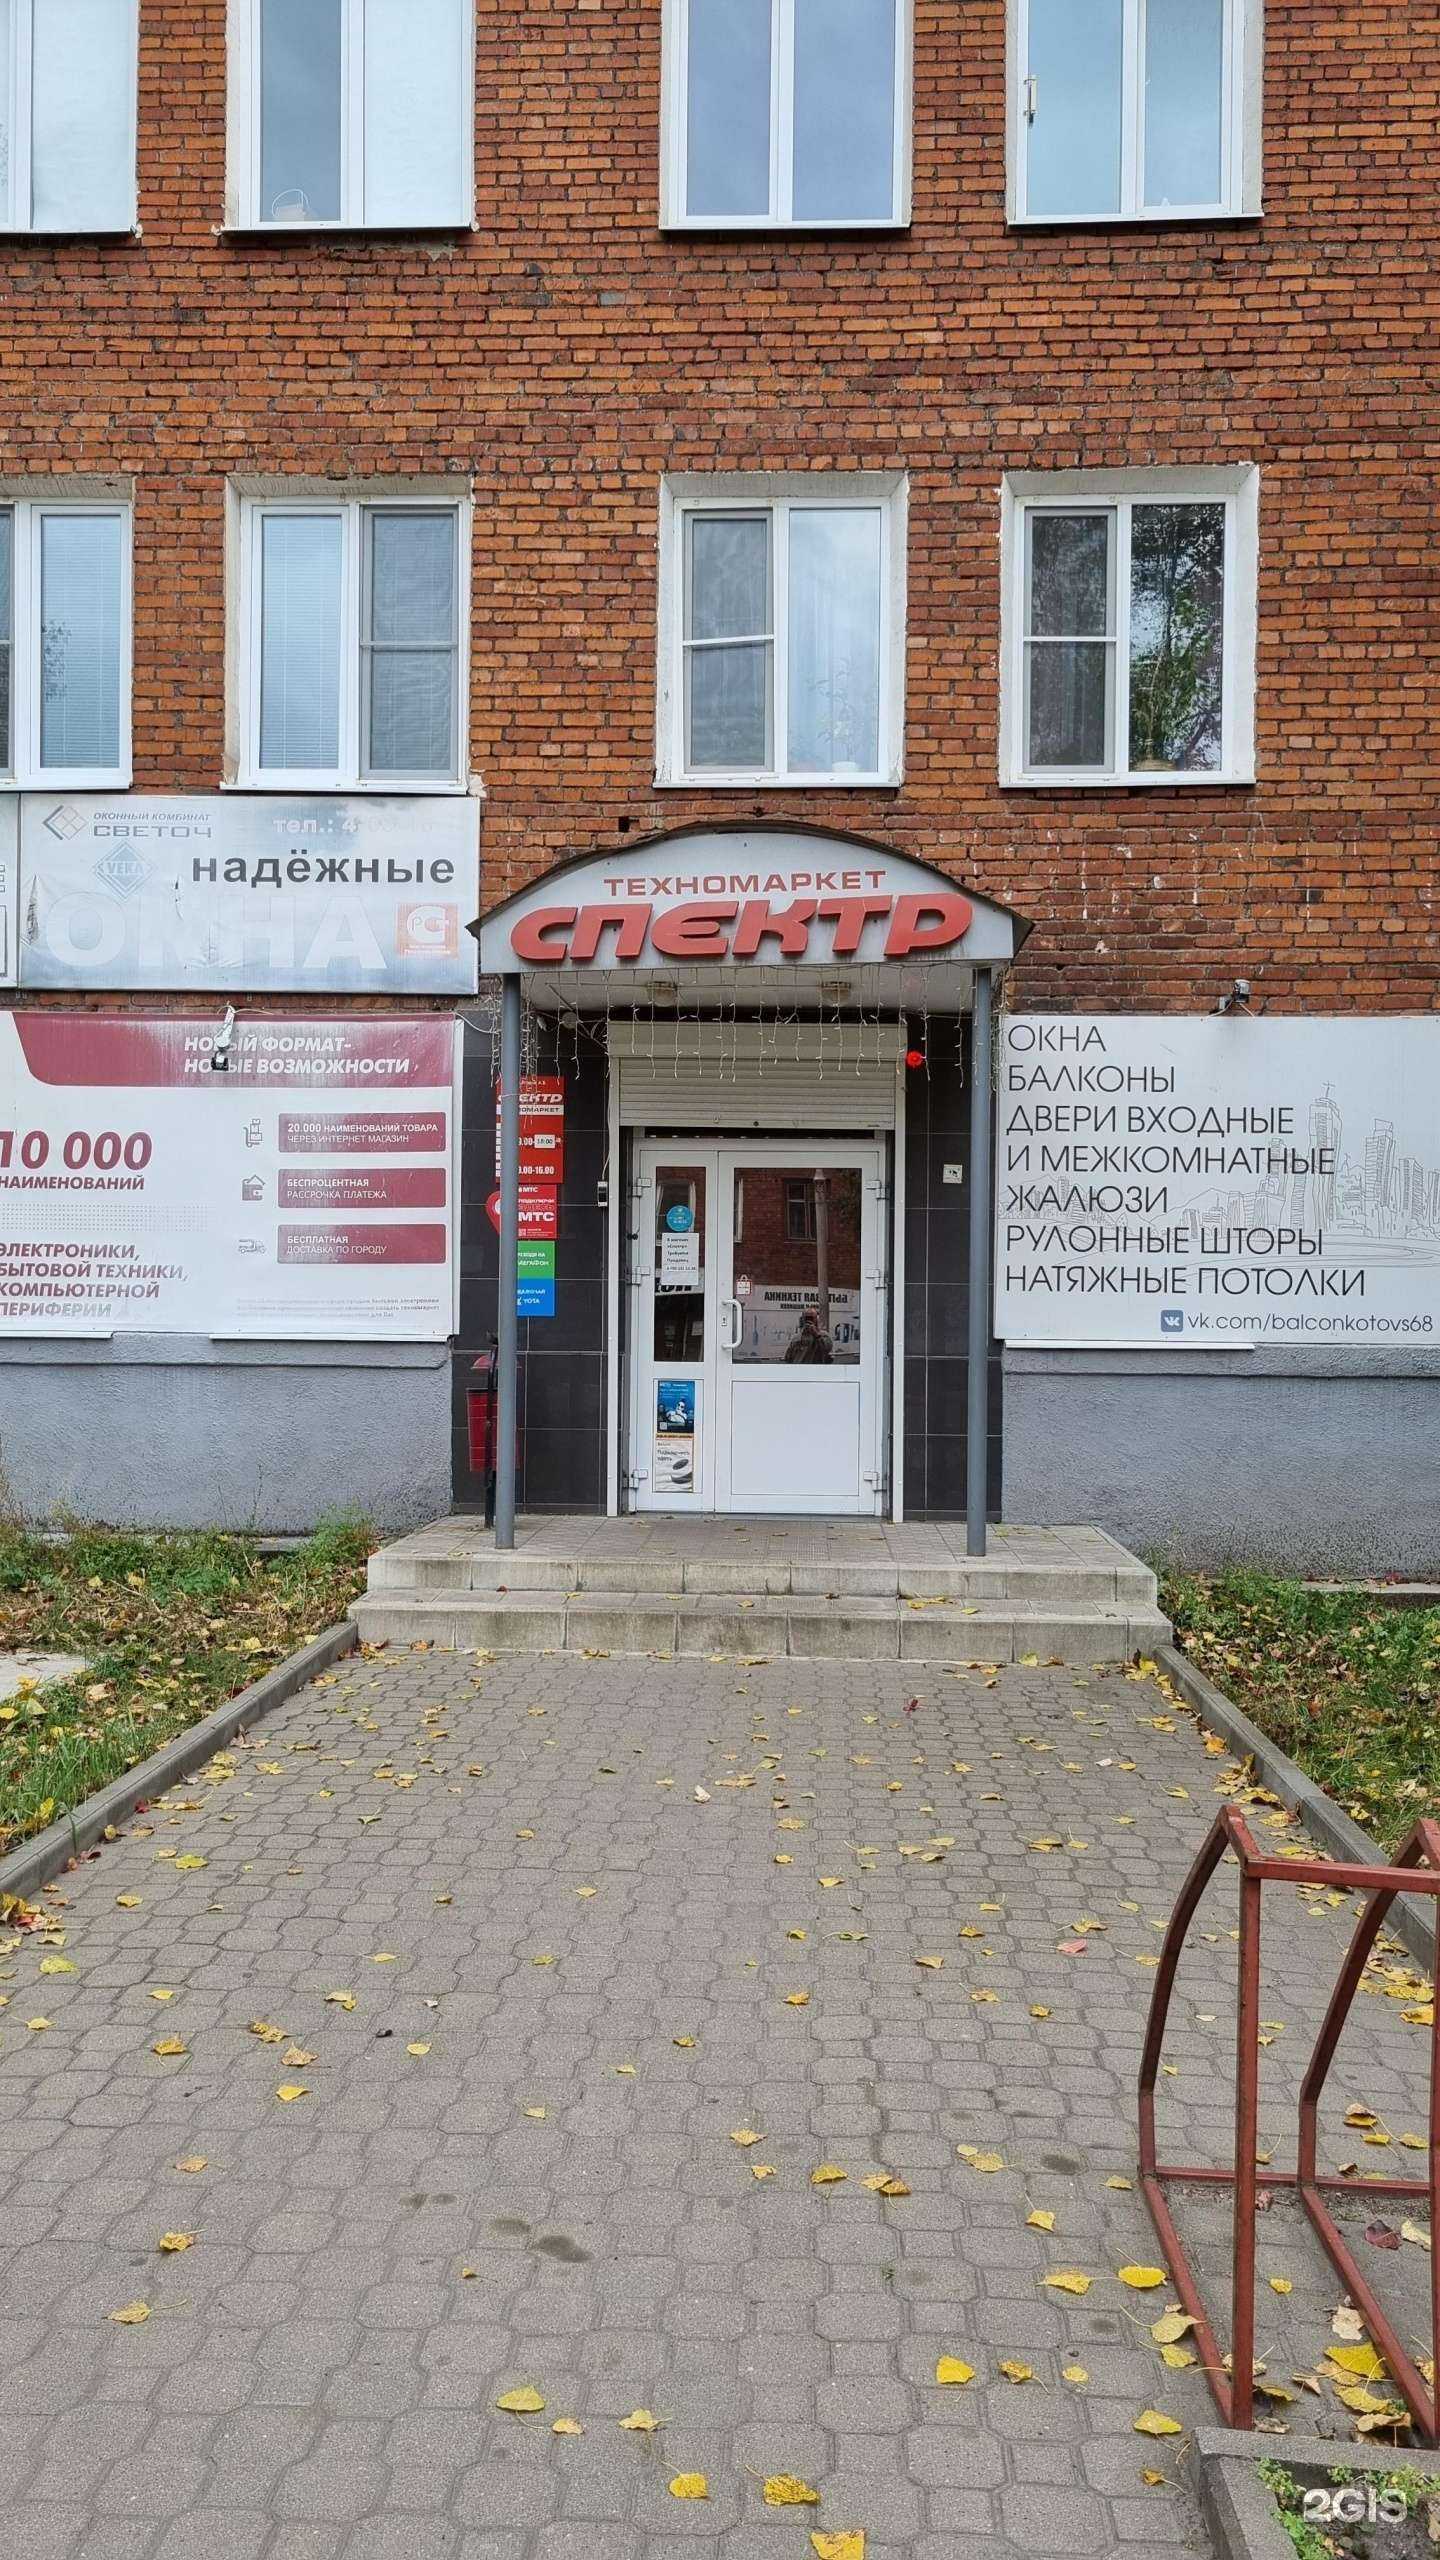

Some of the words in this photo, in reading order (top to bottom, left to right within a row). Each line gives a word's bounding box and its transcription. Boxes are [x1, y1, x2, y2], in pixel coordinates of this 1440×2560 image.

[93, 825, 212, 838] СВЕТОЧ
[192, 849, 455, 888] надёжные
[603, 869, 887, 898] ТЕХНОМАРКЕТ
[510, 891, 974, 960] СПЕКТР
[184, 1034, 257, 1052] НОЫЙ
[1008, 1024, 1107, 1052] ОКНА
[184, 1058, 252, 1074] НОЫЕ
[256, 1058, 410, 1074] ВОЗМОЖНОСТИ
[1009, 1064, 1175, 1093] БАЛКОНЫ
[287, 1123, 322, 1133] 20.000
[324, 1122, 400, 1133] НАИМЕНОВАНИЙ
[403, 1123, 439, 1132] ТОВАРА
[1006, 1104, 1116, 1136] ДВЕРИ
[1127, 1105, 1294, 1138] ВХОДНЫЕ
[287, 1134, 317, 1143] ЧЕРЕЗ
[319, 1134, 366, 1143] ИНТЕРНЕТ
[368, 1134, 409, 1143] МАГАЗИН
[63, 1130, 153, 1171] 000
[1007, 1145, 1030, 1172] И
[1041, 1145, 1335, 1175] МЕЖКОМНАТНЫЕ
[0, 1174, 145, 1190] НАИМЕНОВАНИЙ
[287, 1178, 369, 1188] БЕСПРОЦЕНТНАЯ
[287, 1190, 341, 1199] РАССРОЧКА
[344, 1190, 388, 1199] ПЛАТЕЖА
[1006, 1184, 1168, 1214] ЖАЛЮЗИ
[518, 1211, 555, 1222] МТС
[287, 1235, 349, 1244] БЕСПЛАТНАЯ
[1007, 1224, 1190, 1254] РУЛОННЫЕ
[1200, 1227, 1323, 1255] ШТОРЫ
[287, 1245, 334, 1255] ДОСТАВКА
[337, 1245, 350, 1254] ПО
[352, 1245, 387, 1255] ГОРОДУ
[0, 1260, 92, 1278] БЫТОВОЙ
[96, 1263, 189, 1281] ТЕХНИКИ,
[1006, 1264, 1188, 1294] НАТЯЖНЫЕ
[1198, 1267, 1366, 1296] ПОТОЛКИ
[0, 1281, 161, 1299] КОМПЬЮТЕРНОЙ
[1187, 1312, 1434, 1332] vk.com/balconkotovs68
